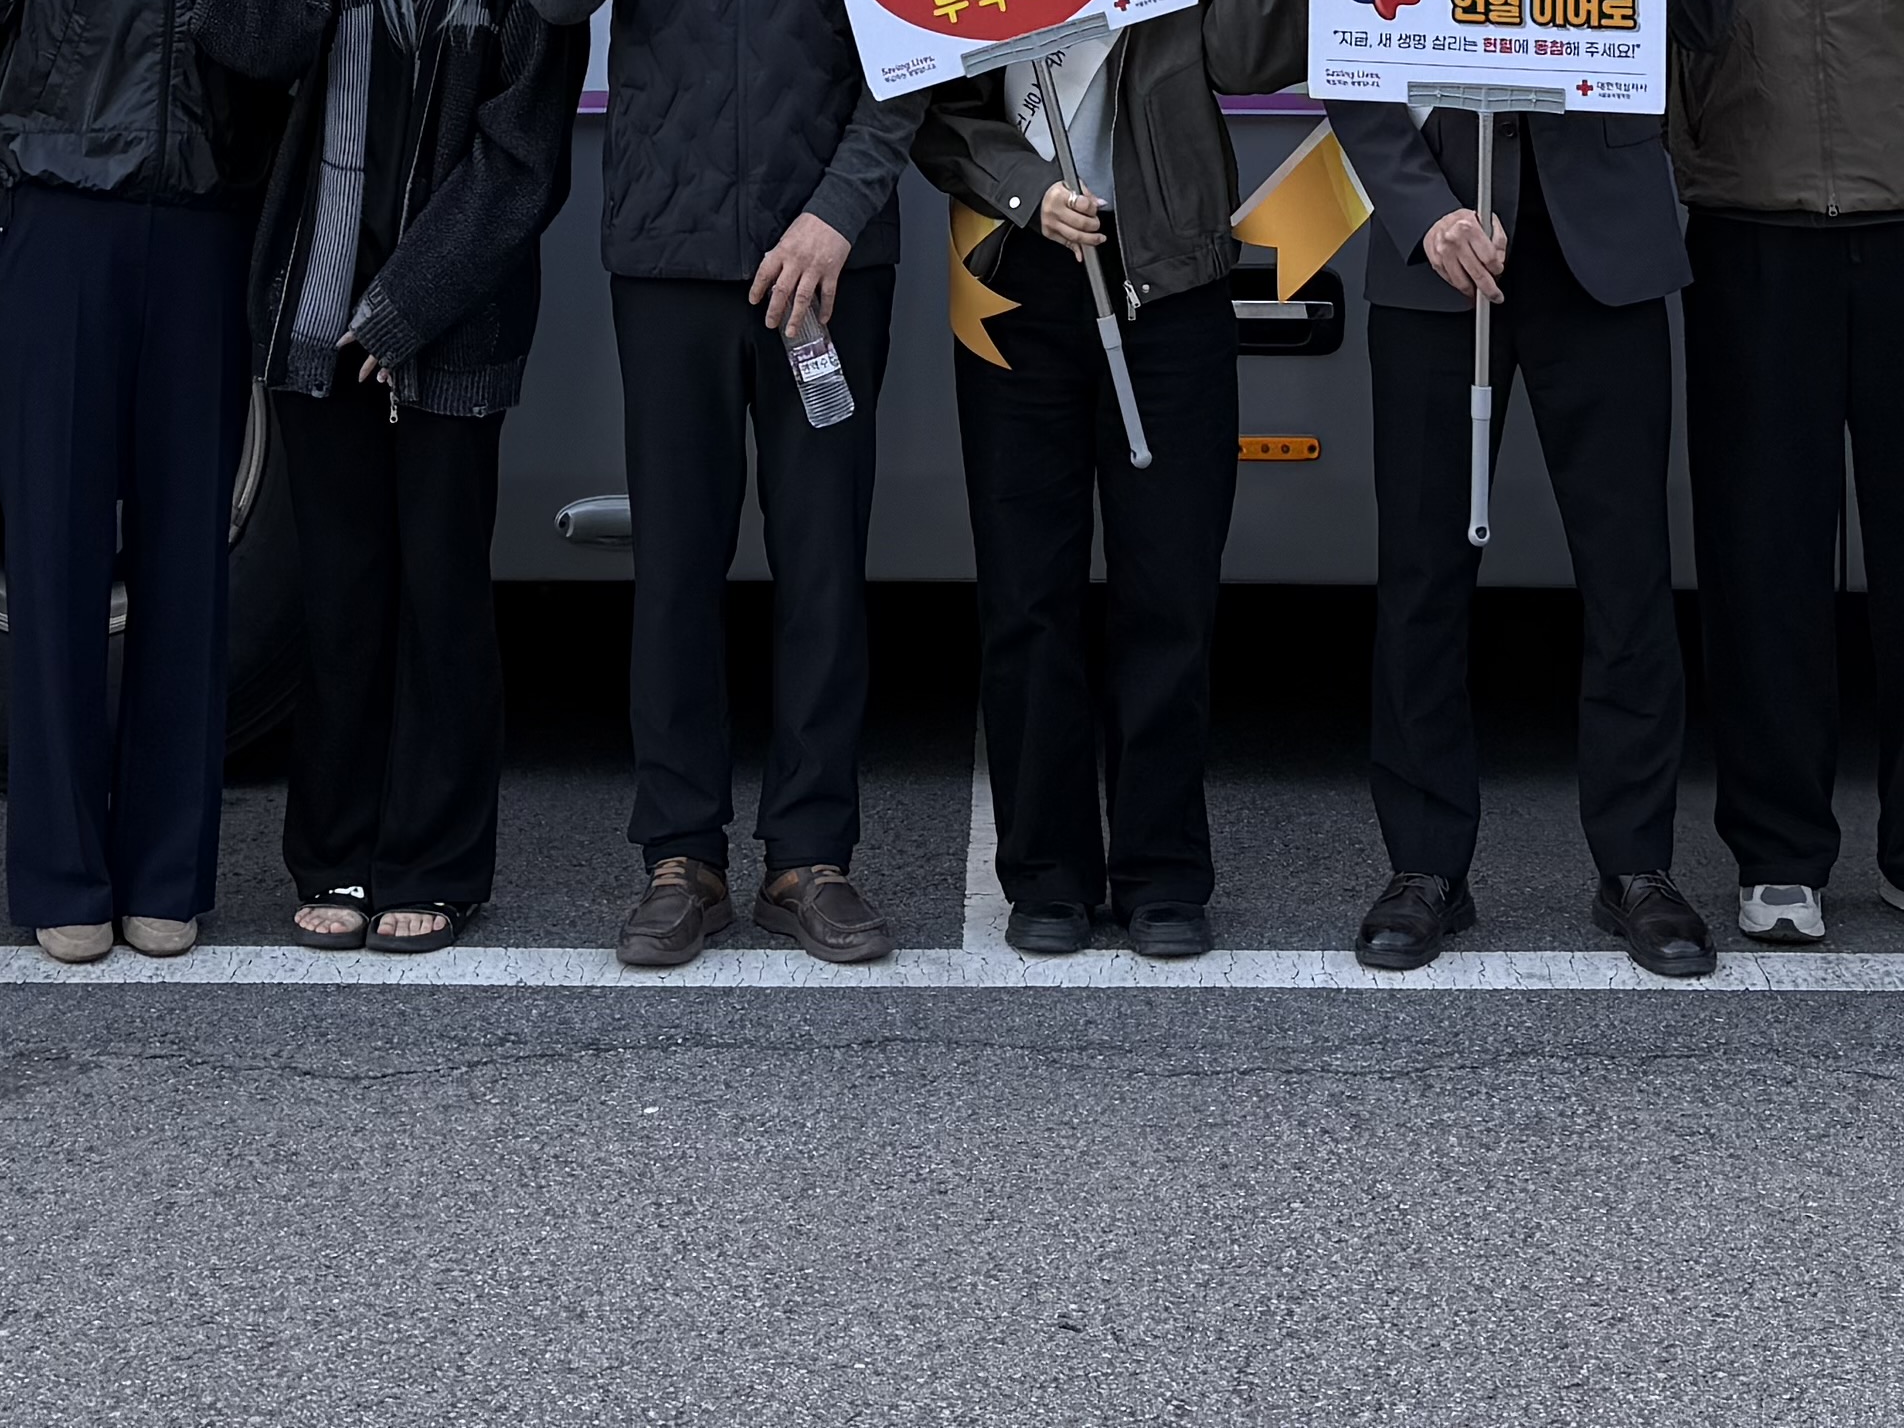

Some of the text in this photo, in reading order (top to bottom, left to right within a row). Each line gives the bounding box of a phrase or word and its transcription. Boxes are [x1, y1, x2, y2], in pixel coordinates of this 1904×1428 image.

[1377, 31, 1392, 48] 새
[1397, 33, 1427, 50] 생명
[1482, 37, 1529, 55] 헌혈에
[1533, 39, 1580, 57] 동참해
